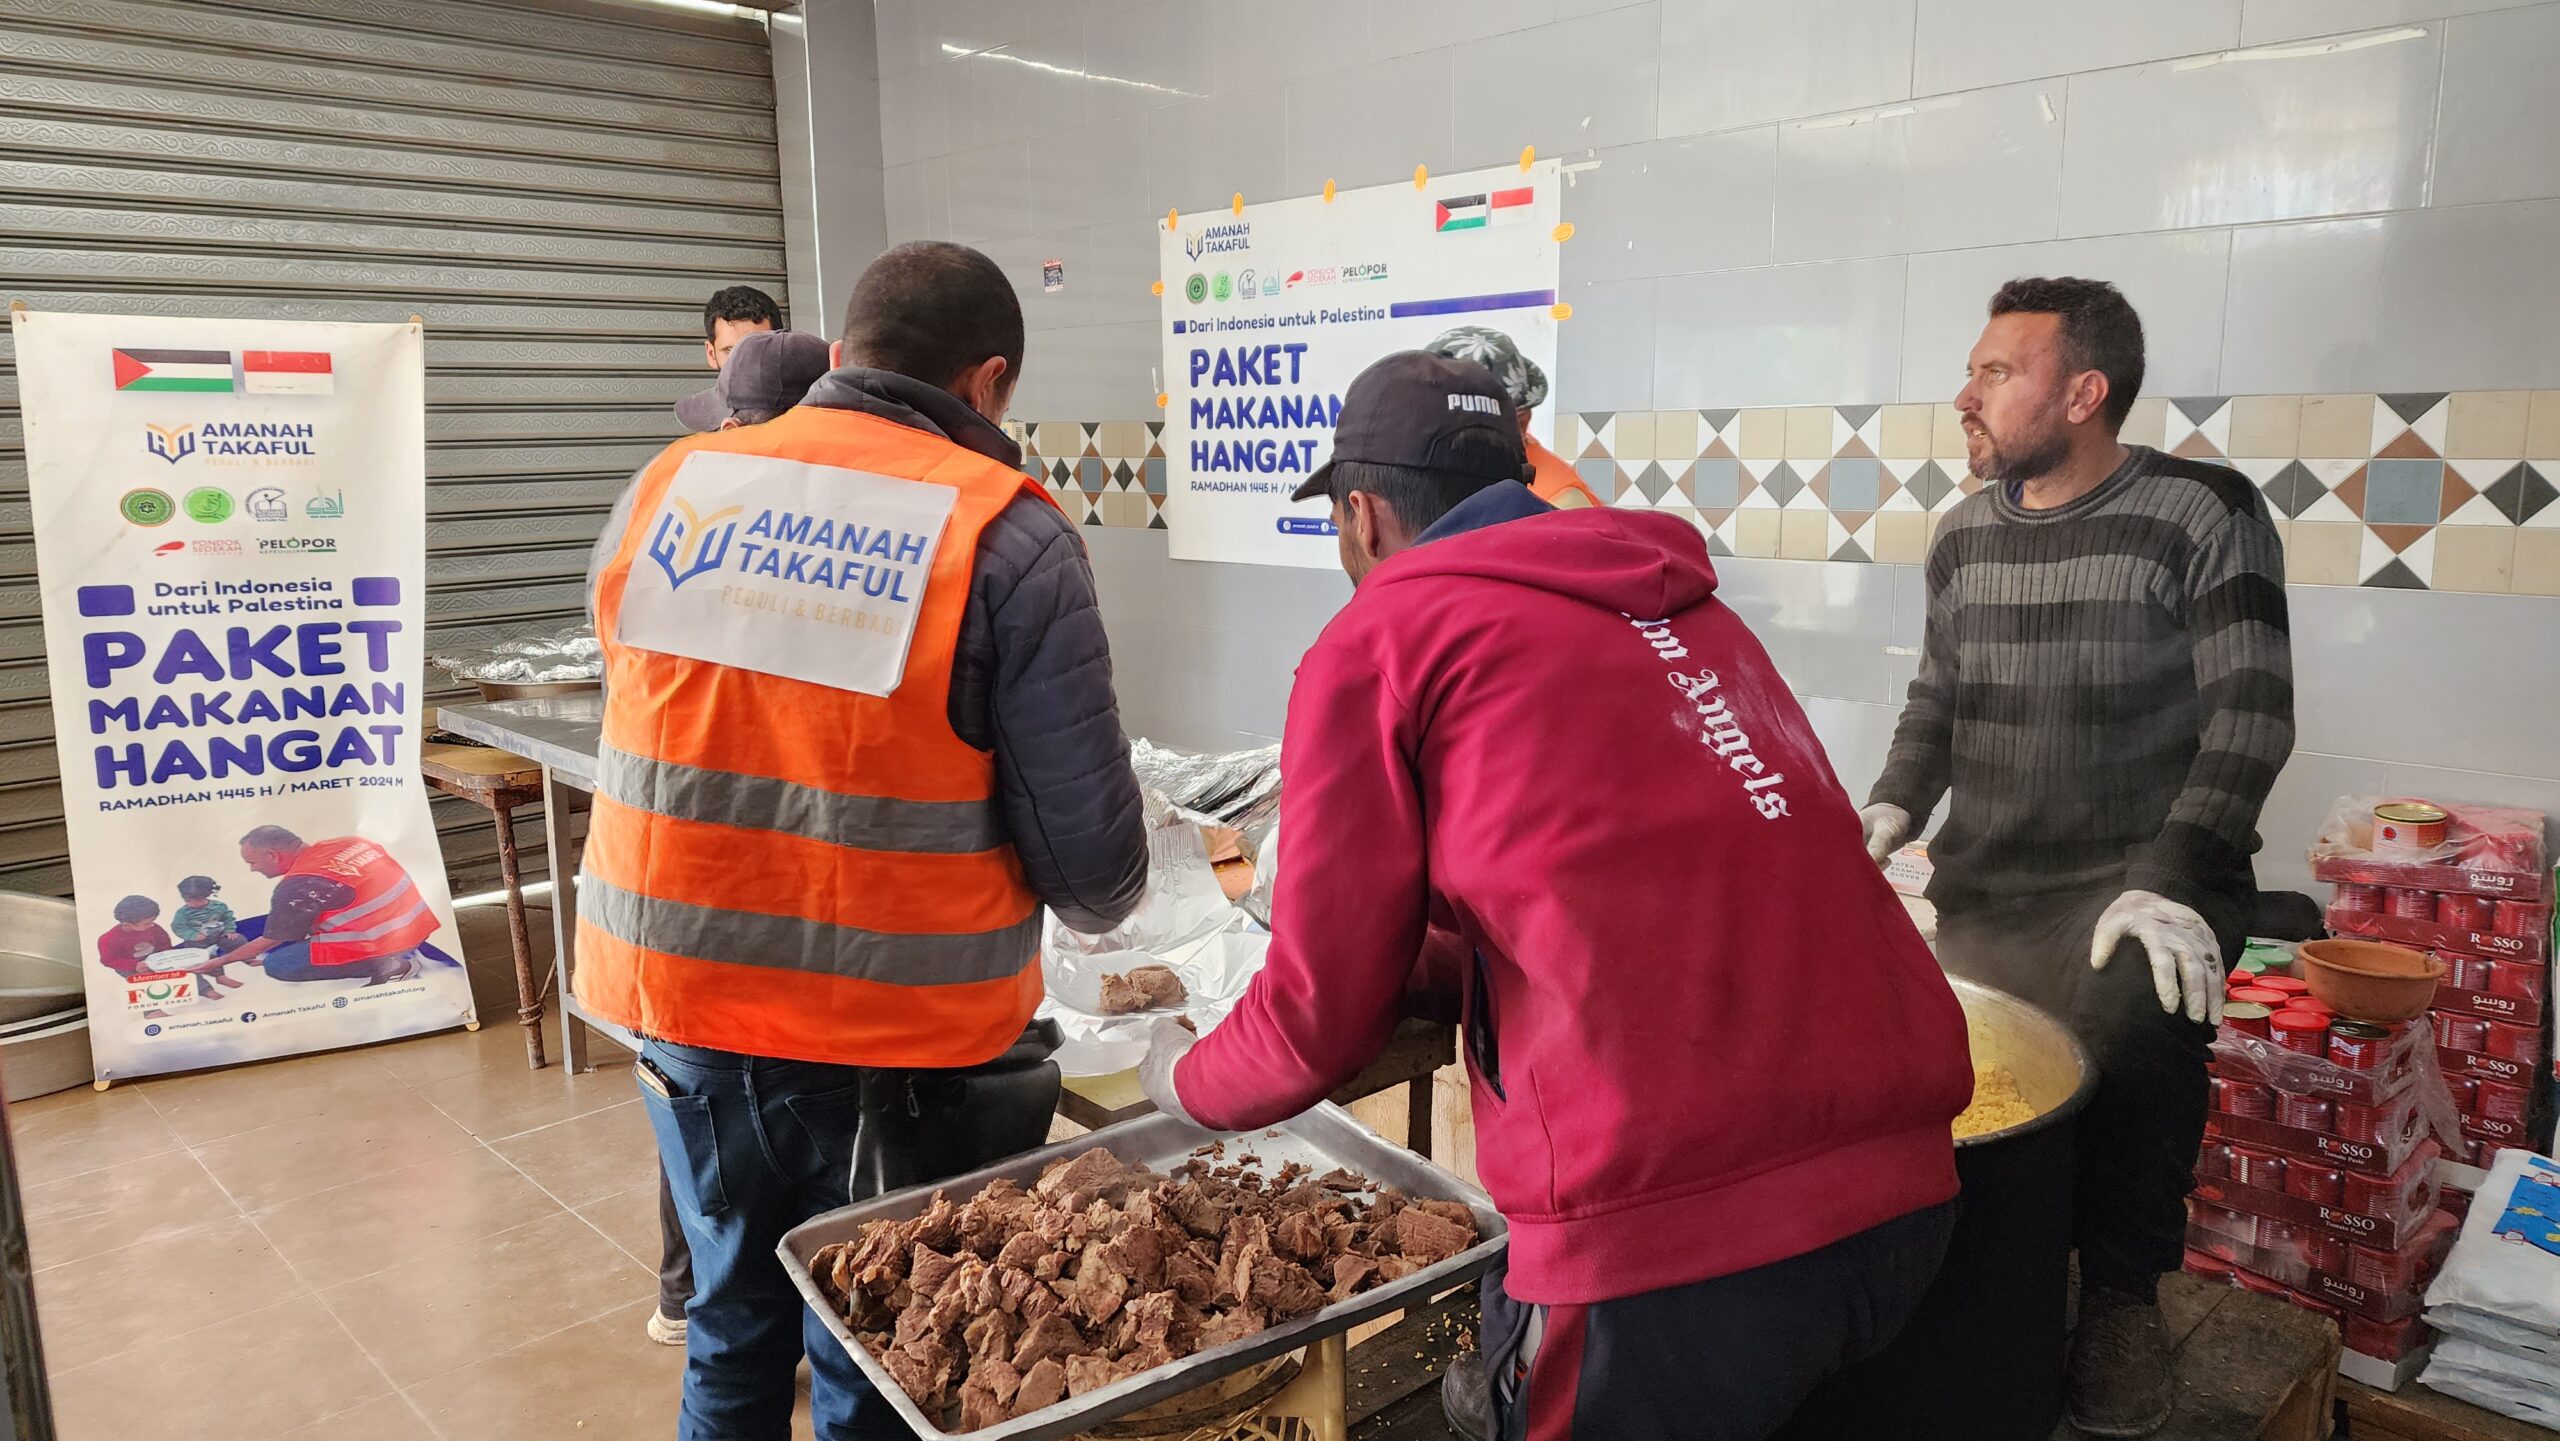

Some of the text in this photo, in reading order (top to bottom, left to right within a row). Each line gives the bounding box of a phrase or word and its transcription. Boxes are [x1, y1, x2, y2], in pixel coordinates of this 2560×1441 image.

[1205, 223, 1250, 240] AMANAH
[1205, 237, 1251, 254] TAKAFUL
[1341, 262, 1388, 278] PELOPOR
[1189, 306, 1386, 334] Dari Indonesia untuk Palestina
[1190, 343, 1308, 388] PAKET
[1448, 394, 1502, 416] PUMA
[201, 422, 314, 438] AMANAH
[201, 440, 316, 455] TAKAFUL
[1190, 439, 1319, 473] HANGAT
[1190, 481, 1247, 493] RAMADHAN
[1249, 482, 1269, 494] 1445
[1271, 483, 1278, 494] H
[192, 539, 241, 547] PONDOK
[258, 537, 336, 549] PELOPOR
[745, 509, 928, 566] AMANAH
[193, 546, 242, 554] SEDEKAH
[738, 542, 910, 603] TAKAFUL
[154, 577, 333, 598] Dari Indonesia
[148, 595, 343, 616] untuk Palestina
[722, 585, 904, 637] PEDULI & BERBAGI
[83, 620, 403, 689] PAKET
[89, 682, 404, 735] MAKANAN
[1667, 668, 1792, 820] Angels
[95, 725, 404, 789] HANGAT
[99, 776, 404, 812] RAMADHAN 1445 H / MARET 2024 M
[1891, 866, 1932, 876] EXAMINAT
[2470, 873, 2514, 887] روسو
[2470, 932, 2523, 950] ROSSO
[132, 972, 169, 983] Member
[127, 998, 193, 1010] FORUM ZAKAT
[353, 985, 426, 1003] amanahtakaful.org
[2472, 995, 2516, 1011] روسو
[262, 1003, 326, 1018] Amanah Takaful
[2467, 1055, 2519, 1075] ROSSO
[2309, 1072, 2354, 1090] روسو
[2460, 1113, 2513, 1134] ROSSO
[2318, 1137, 2373, 1159] ROSSO
[2320, 1207, 2376, 1231] ROSSO
[2322, 1276, 2365, 1300] روسو
